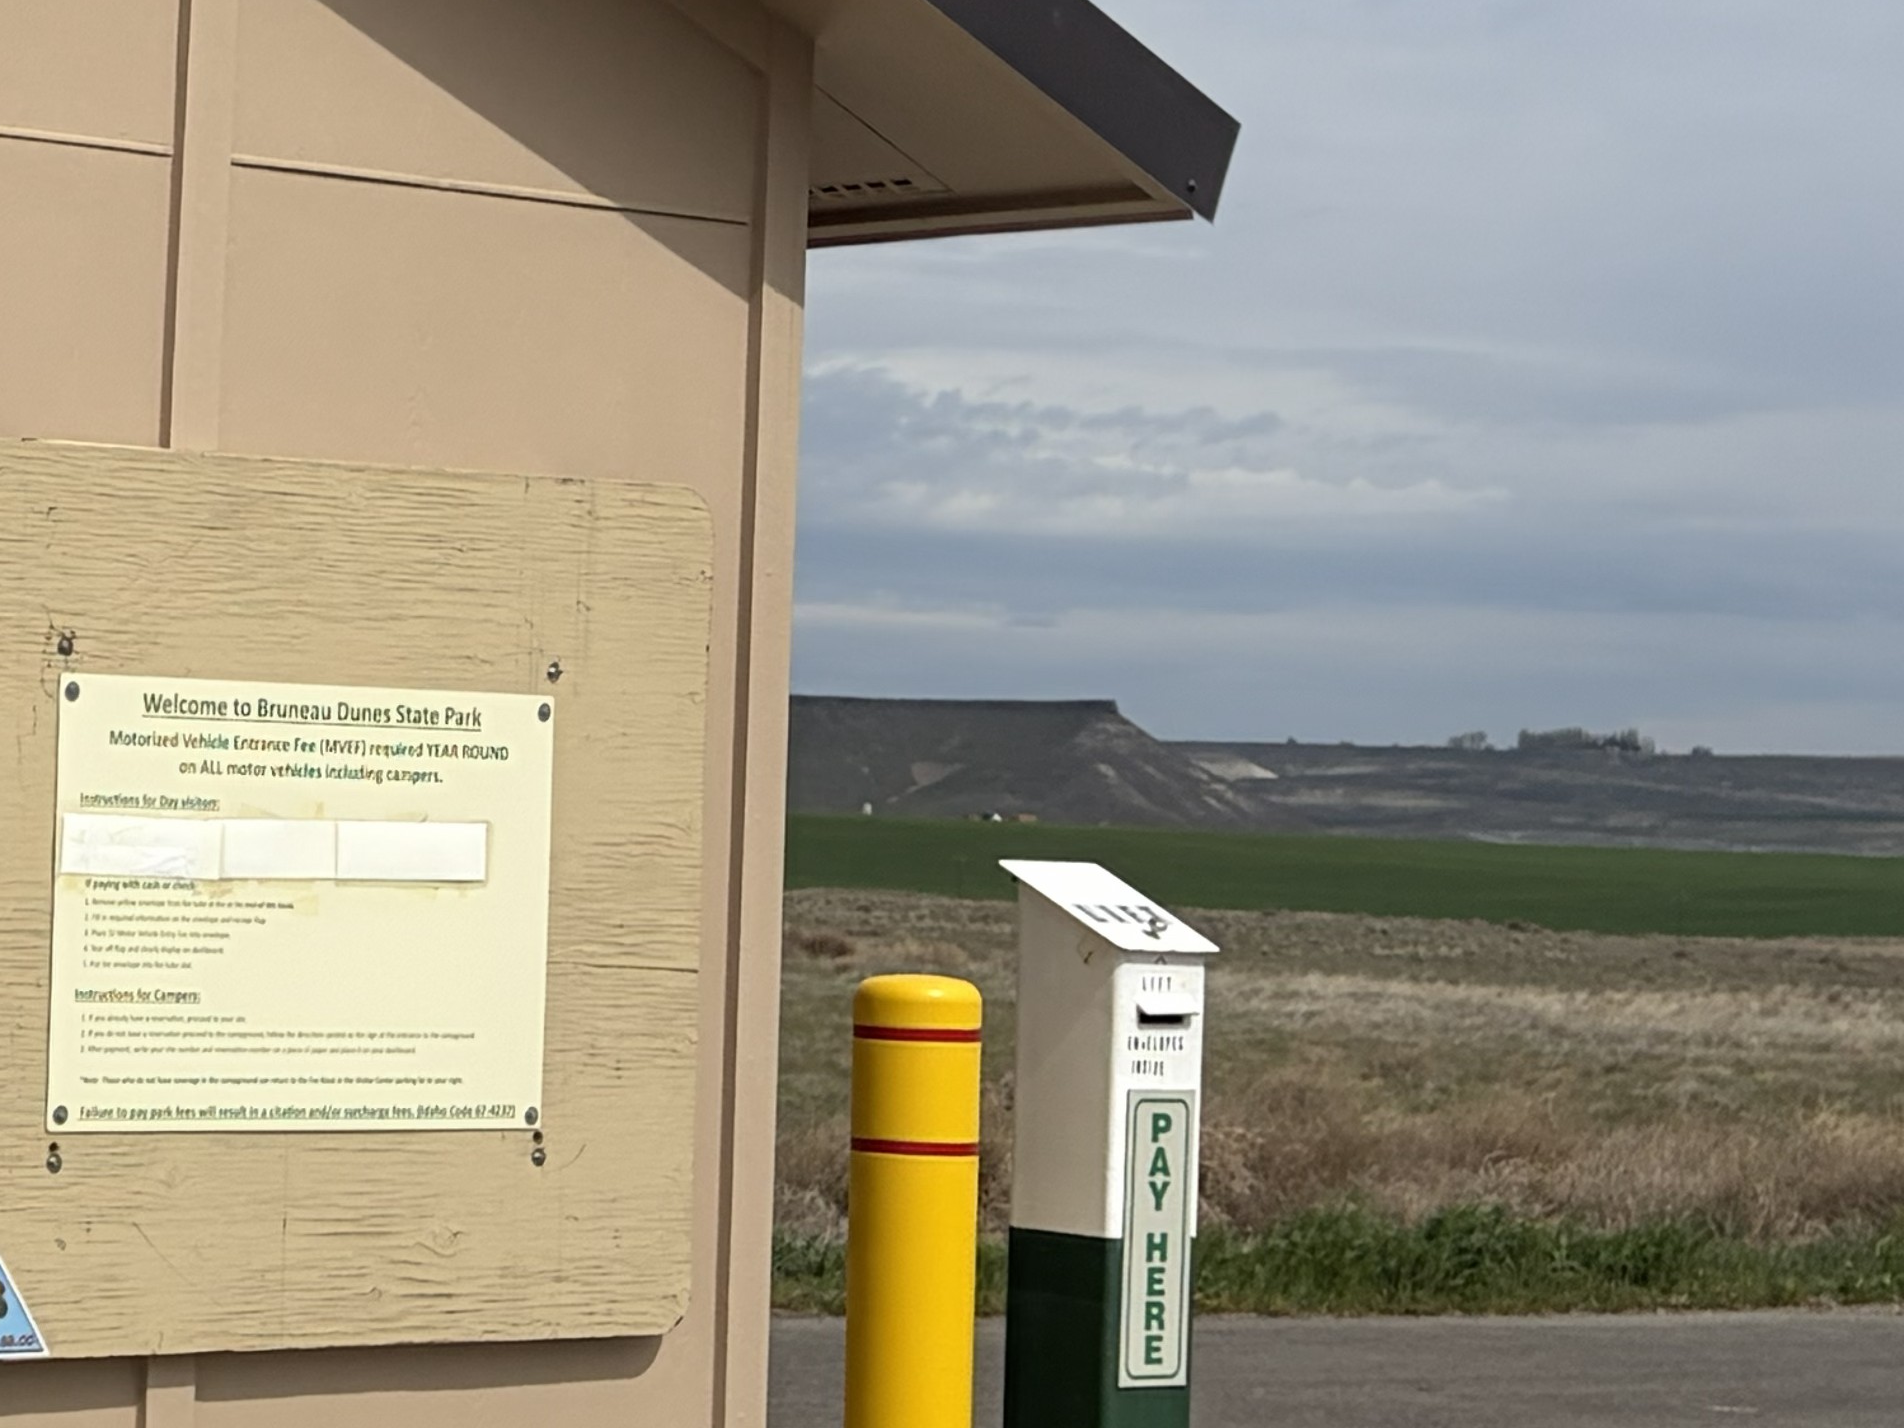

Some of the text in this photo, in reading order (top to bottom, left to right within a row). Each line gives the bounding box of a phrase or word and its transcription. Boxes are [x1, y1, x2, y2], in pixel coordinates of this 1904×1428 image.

[143, 693, 482, 727] Welcome to Bruneau Dunes State Park
[109, 730, 509, 760] Motorized Vehicle Entrance Fee (MVEF) required YEAR ROUND
[179, 760, 443, 784] on ALL motor vehicles including campers.
[80, 792, 139, 806] Instructions
[143, 793, 157, 806] for
[160, 795, 178, 810] Day
[1142, 976, 1172, 991] LIFT
[75, 989, 134, 1002] Instructions
[137, 988, 151, 1001] for
[1127, 1035, 1184, 1051] ENVELOPES
[1131, 1060, 1164, 1076] INSIDE
[80, 1106, 113, 1118] Failure
[116, 1107, 127, 1118] to
[130, 1109, 148, 1120] pay
[150, 1106, 172, 1120] park
[176, 1106, 195, 1118] fees
[199, 1105, 216, 1118] will
[219, 1105, 247, 1118] result
[249, 1106, 258, 1118] in
[269, 1106, 306, 1118] citation
[309, 1105, 341, 1119] and/or
[344, 1105, 390, 1120] surcharge
[450, 1105, 472, 1118] Code
[1144, 1112, 1173, 1365] PAY HERE
